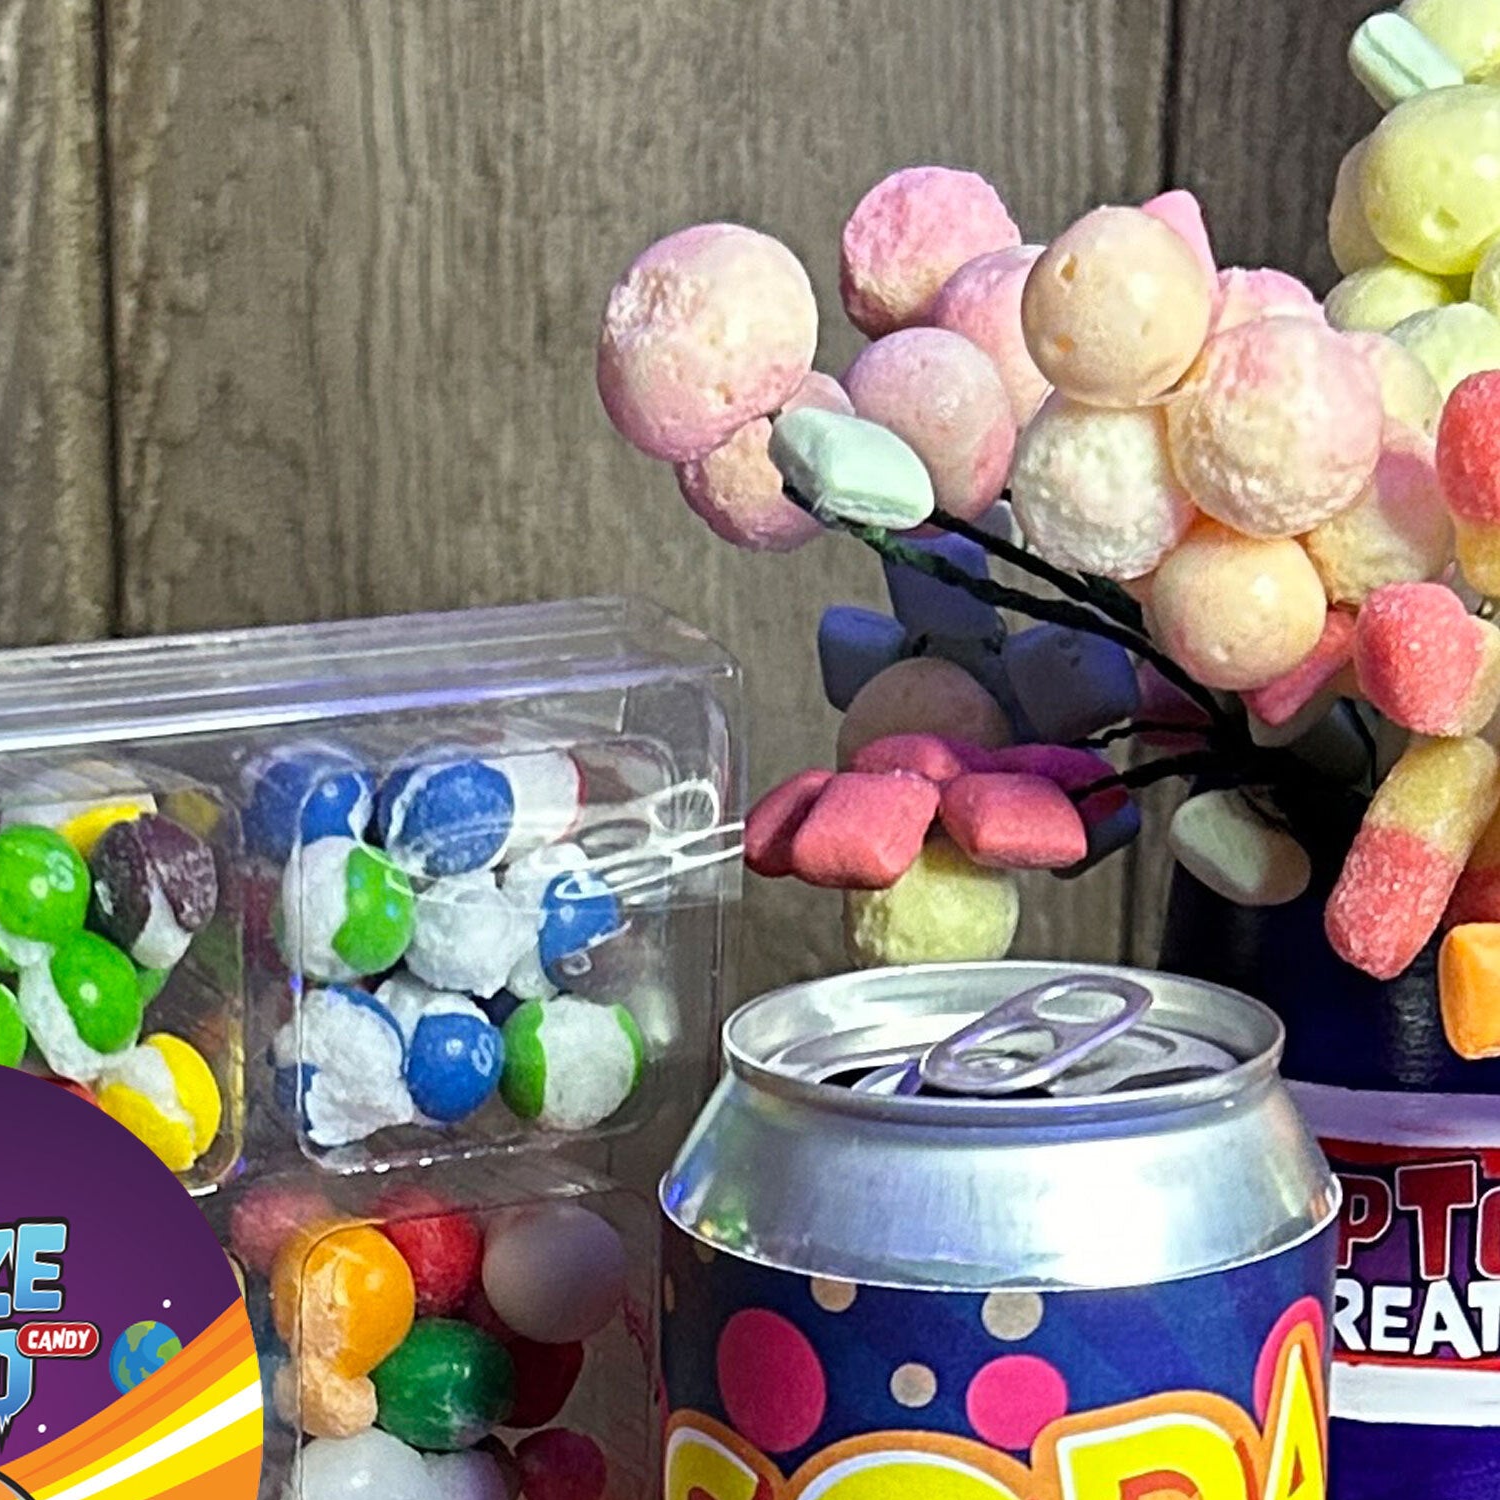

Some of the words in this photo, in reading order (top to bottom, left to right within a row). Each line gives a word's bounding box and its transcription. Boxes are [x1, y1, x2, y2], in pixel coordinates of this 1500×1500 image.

[471, 1033, 495, 1077] S
[1337, 1160, 1500, 1280] PT
[27, 1327, 91, 1353] CANDY
